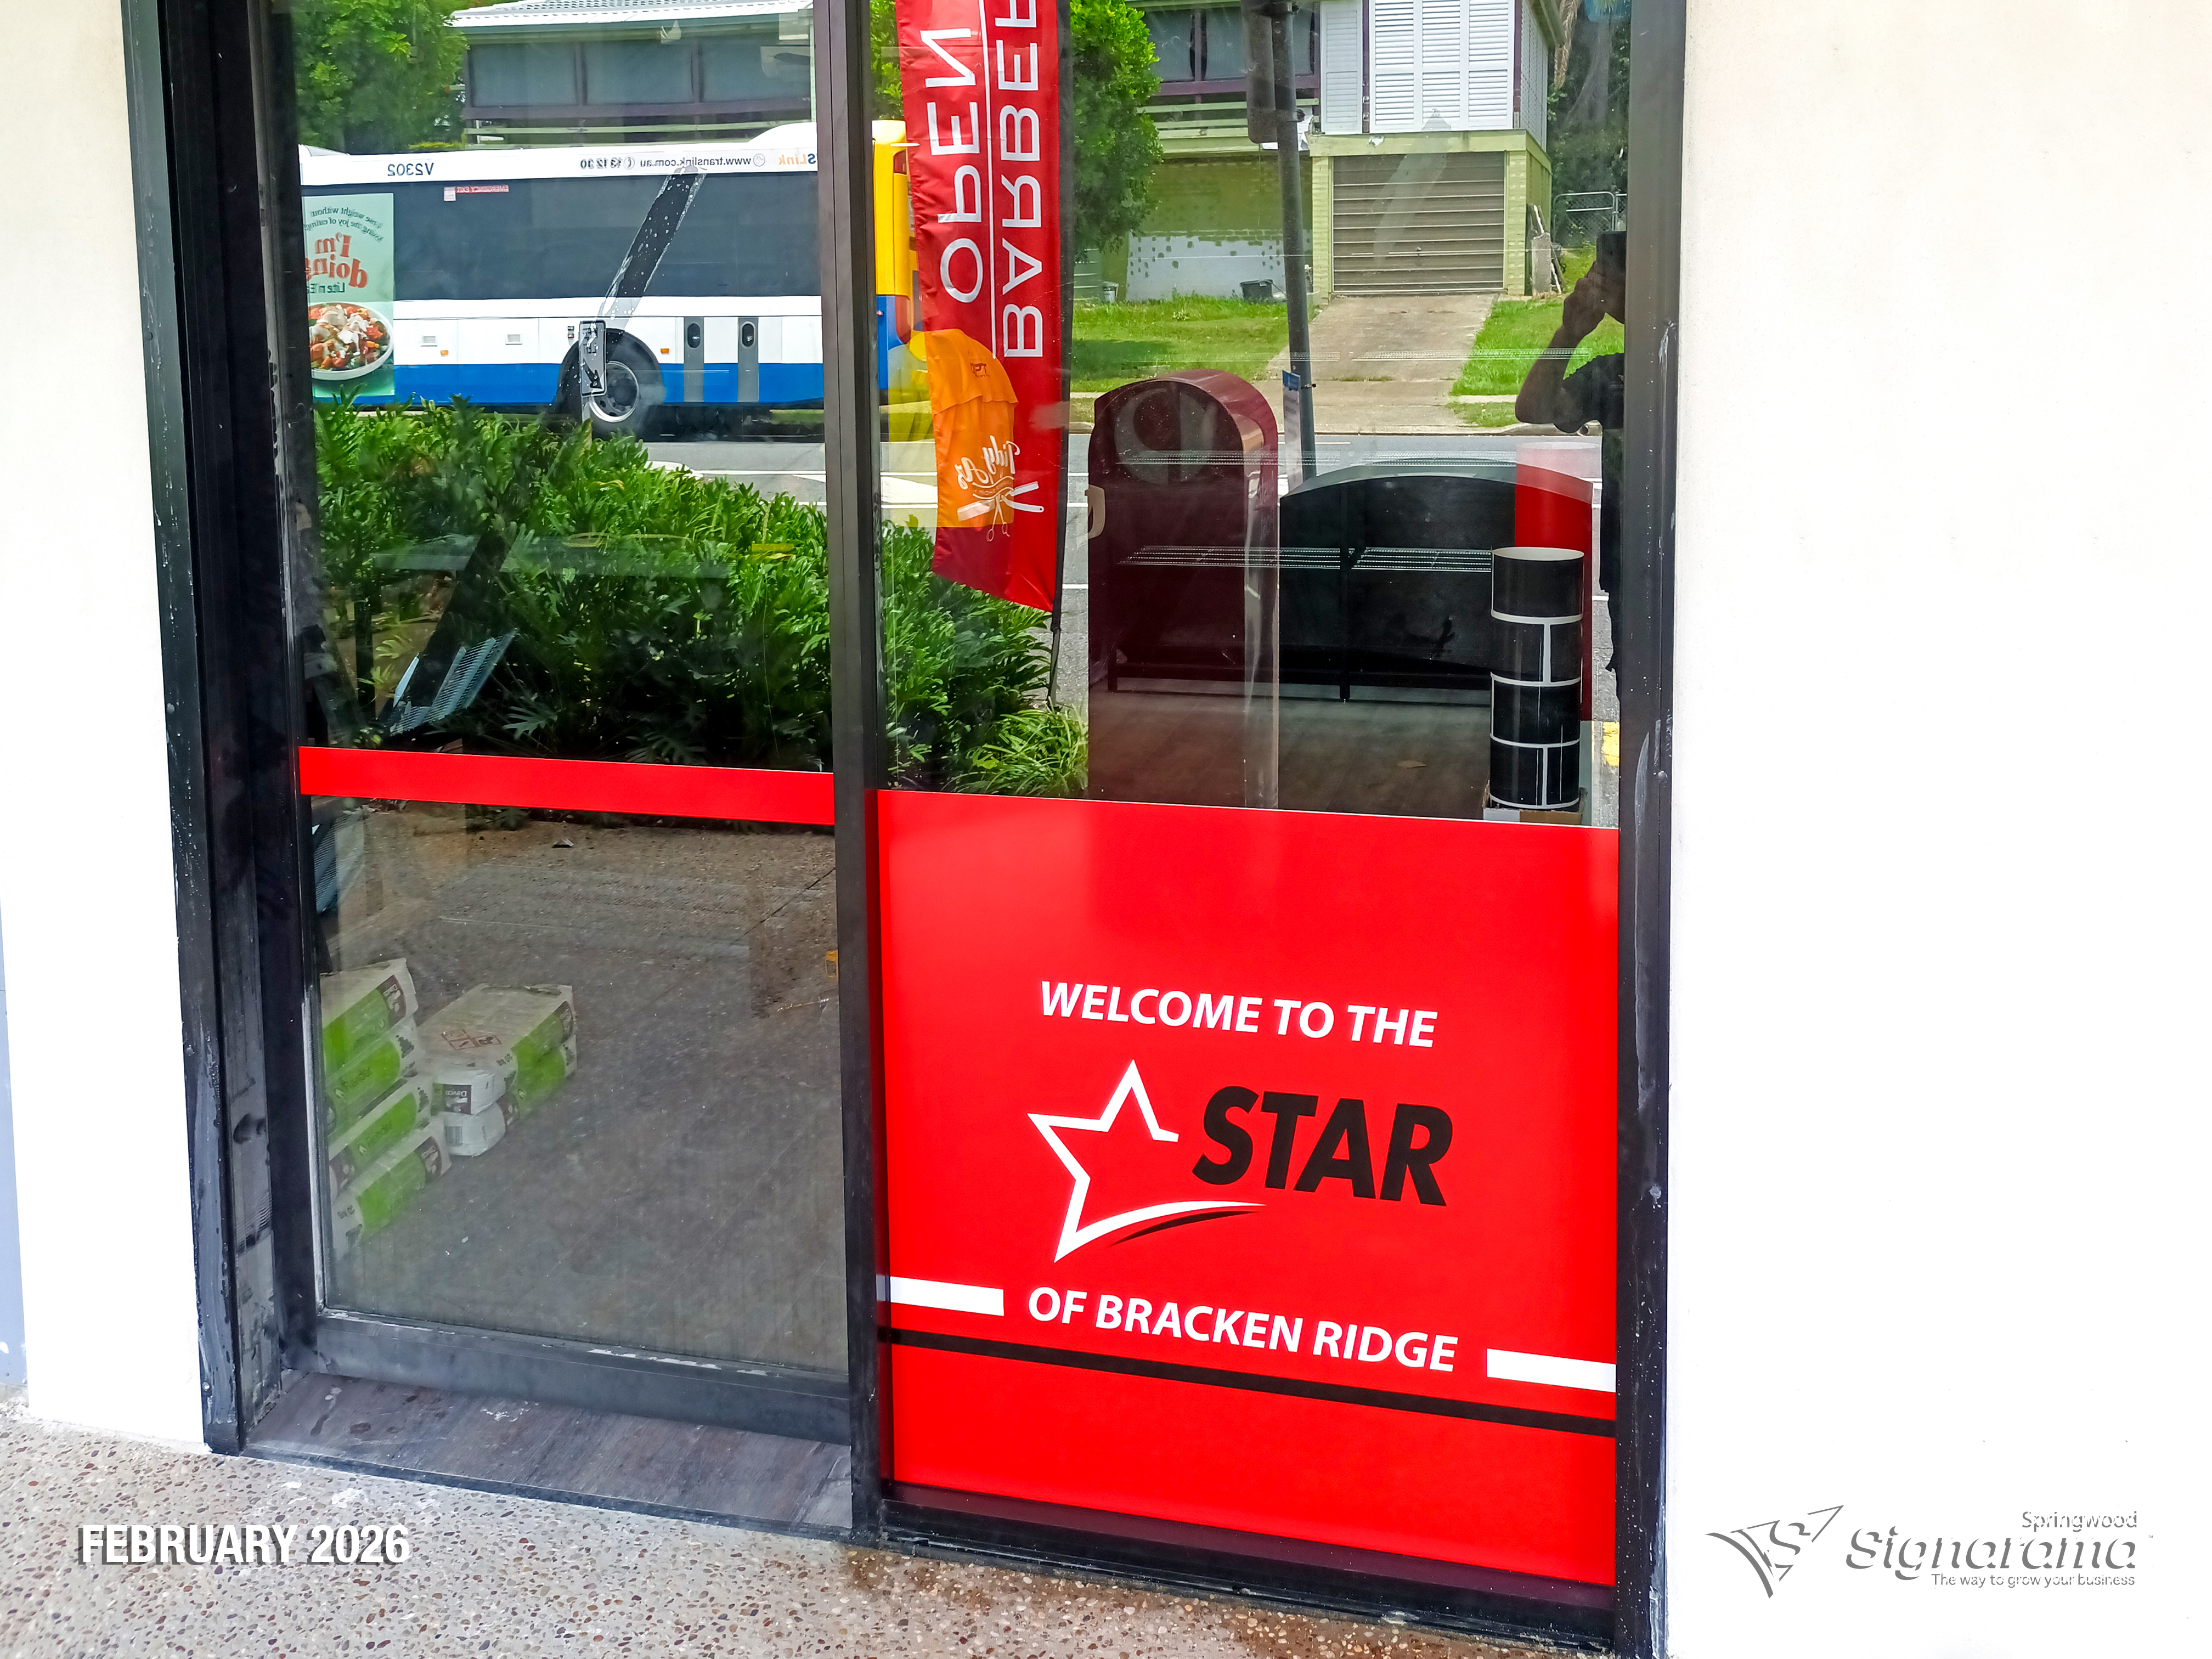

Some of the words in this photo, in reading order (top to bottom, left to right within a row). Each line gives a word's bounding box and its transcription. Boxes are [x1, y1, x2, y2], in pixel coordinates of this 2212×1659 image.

[1041, 980, 1263, 1034] WELCOME
[1273, 998, 1335, 1039] TO
[1346, 1005, 1438, 1048] THE
[1192, 1085, 1453, 1207] STAR
[1028, 1286, 1088, 1325] OF
[1096, 1294, 1304, 1354] BRACKEN
[1312, 1320, 1459, 1373] RIDGE
